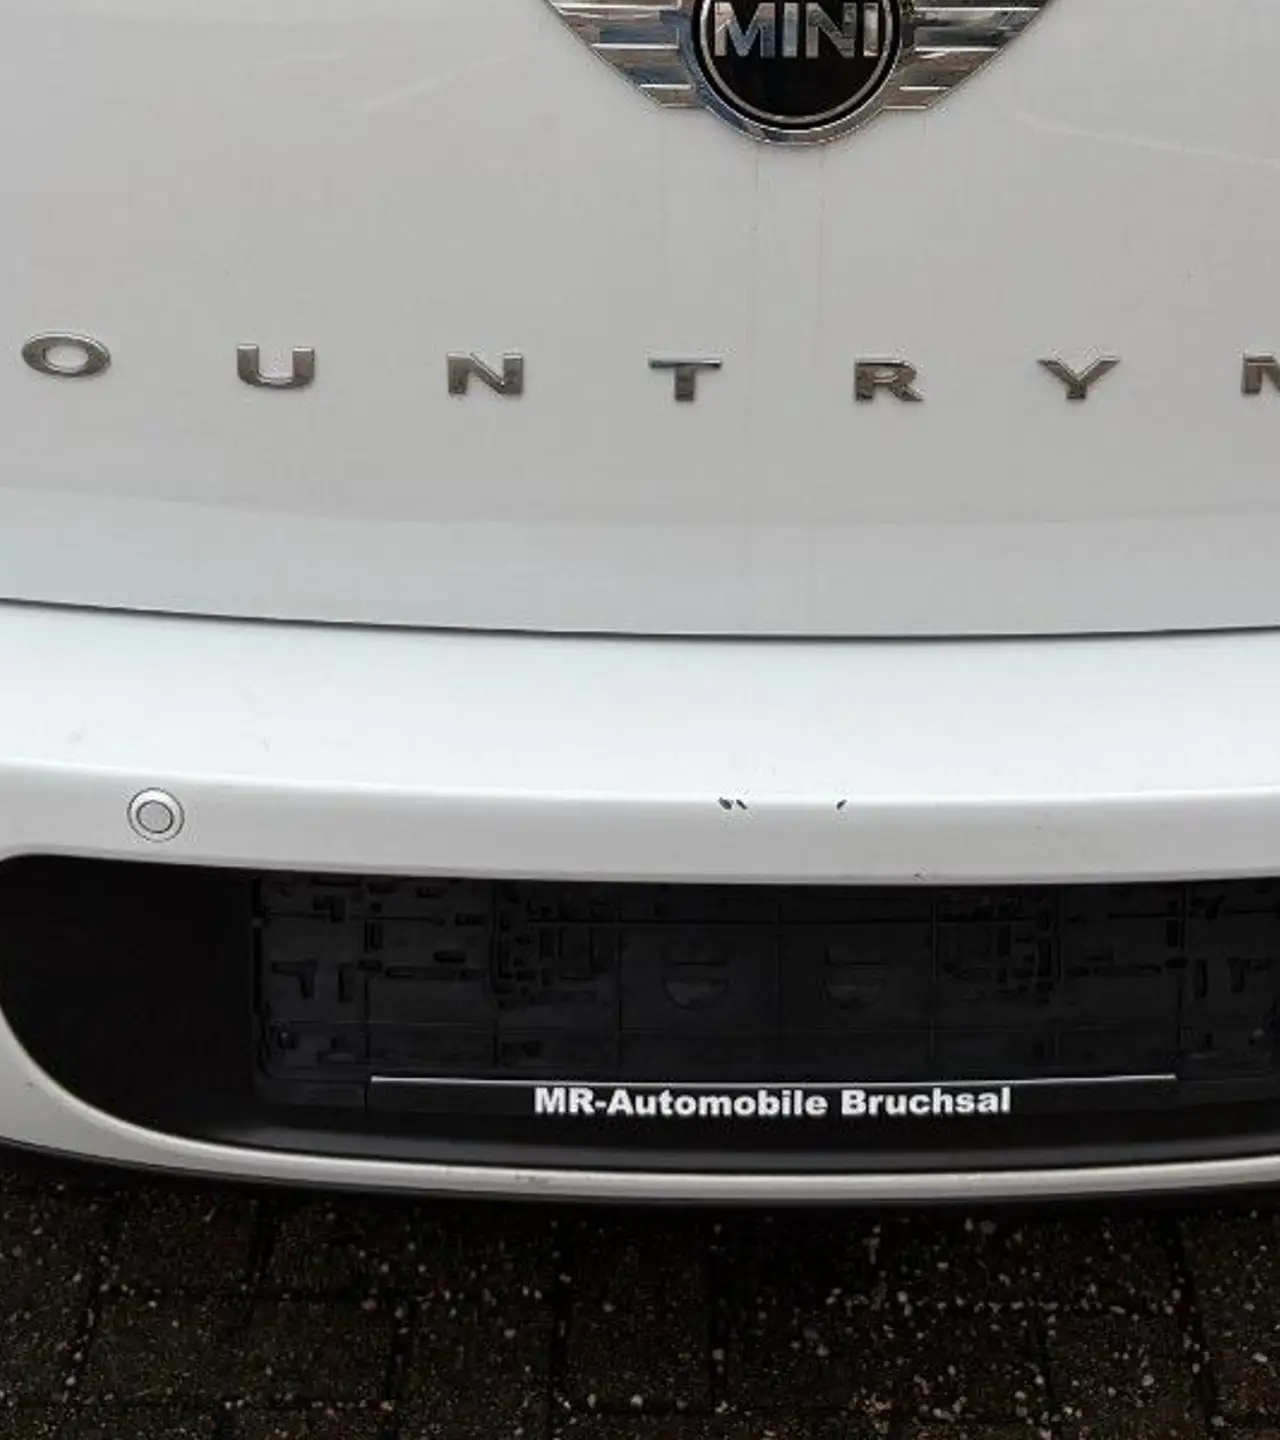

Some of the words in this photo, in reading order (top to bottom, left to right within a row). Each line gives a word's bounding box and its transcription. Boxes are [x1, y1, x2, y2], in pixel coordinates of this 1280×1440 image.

[713, 1, 880, 58] MINI
[533, 1086, 828, 1117] MR-Automobile
[840, 1086, 1012, 1117] Bruchsal
